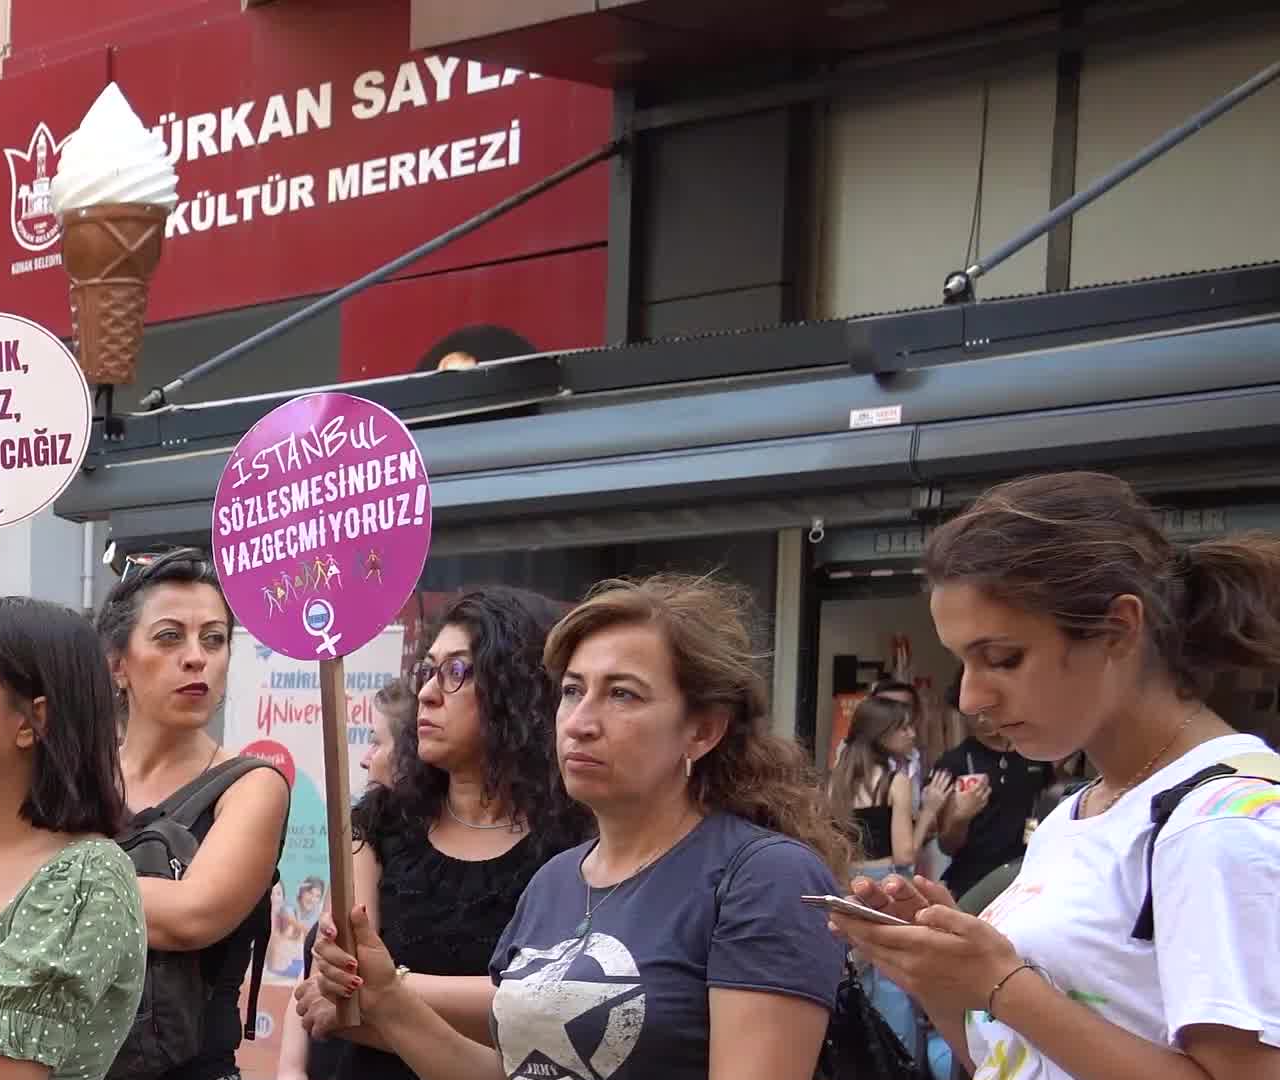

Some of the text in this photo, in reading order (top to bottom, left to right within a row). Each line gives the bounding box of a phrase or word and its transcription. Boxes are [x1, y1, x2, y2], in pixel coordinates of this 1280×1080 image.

[148, 82, 332, 165] ÜRKAN
[165, 119, 521, 239] KÜLTÜR MERKEZİ
[218, 448, 418, 537] SÖZLEŞMESİNDEN
[231, 415, 389, 489] İSTANBUL
[220, 484, 427, 577] VAZGEÇMİYORUZ!
